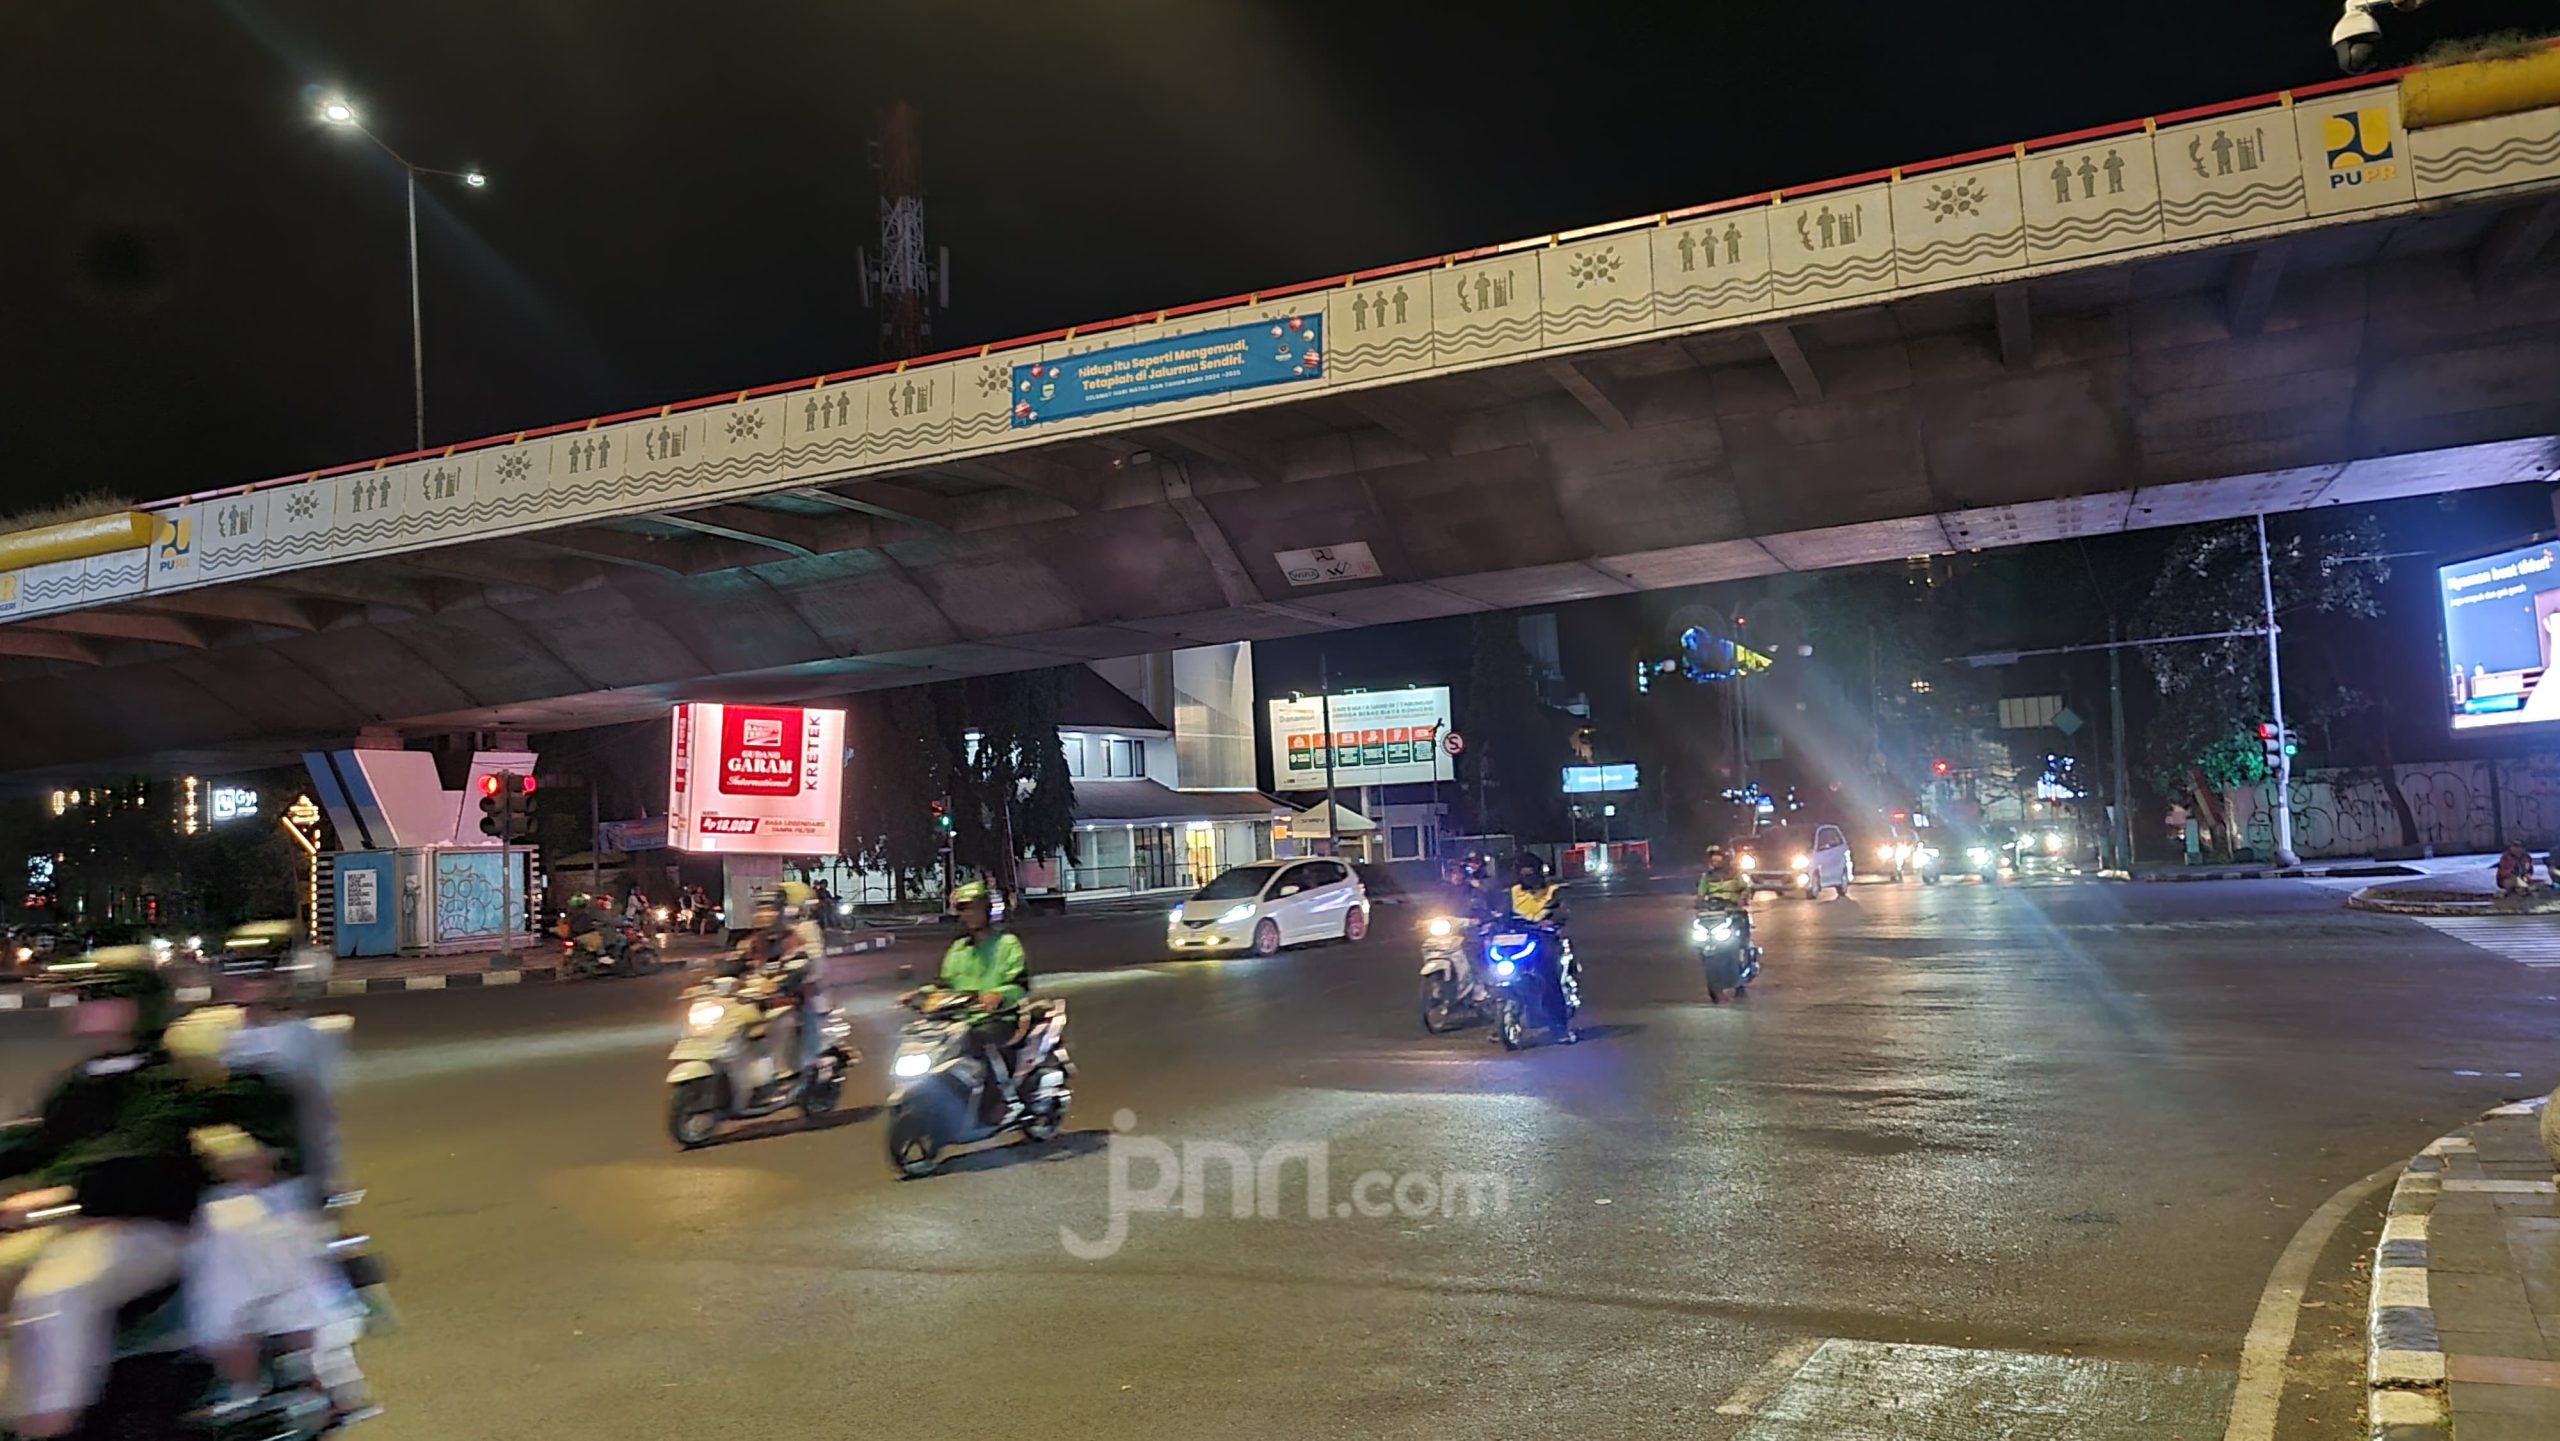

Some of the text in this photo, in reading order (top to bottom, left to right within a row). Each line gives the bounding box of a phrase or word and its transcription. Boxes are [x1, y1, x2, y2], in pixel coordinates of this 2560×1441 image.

[2330, 165, 2398, 189] PUPR
[1078, 338, 1249, 377] Hidup itu Seperti Mengemudi,
[1082, 353, 1246, 390] Tetaplah di Jalurmu Sendiri.
[1085, 391, 1112, 401] SELAMAT
[1113, 388, 1128, 396] HARI
[1129, 385, 1149, 394] NATAL
[1164, 379, 1186, 387] TAHUN
[1187, 376, 1203, 384] BARU
[1204, 373, 1220, 381] 2024
[727, 757, 793, 774] GARAM
[741, 749, 781, 760] GUDANG
[805, 715, 822, 791] KRETEK
[726, 774, 793, 788] International
